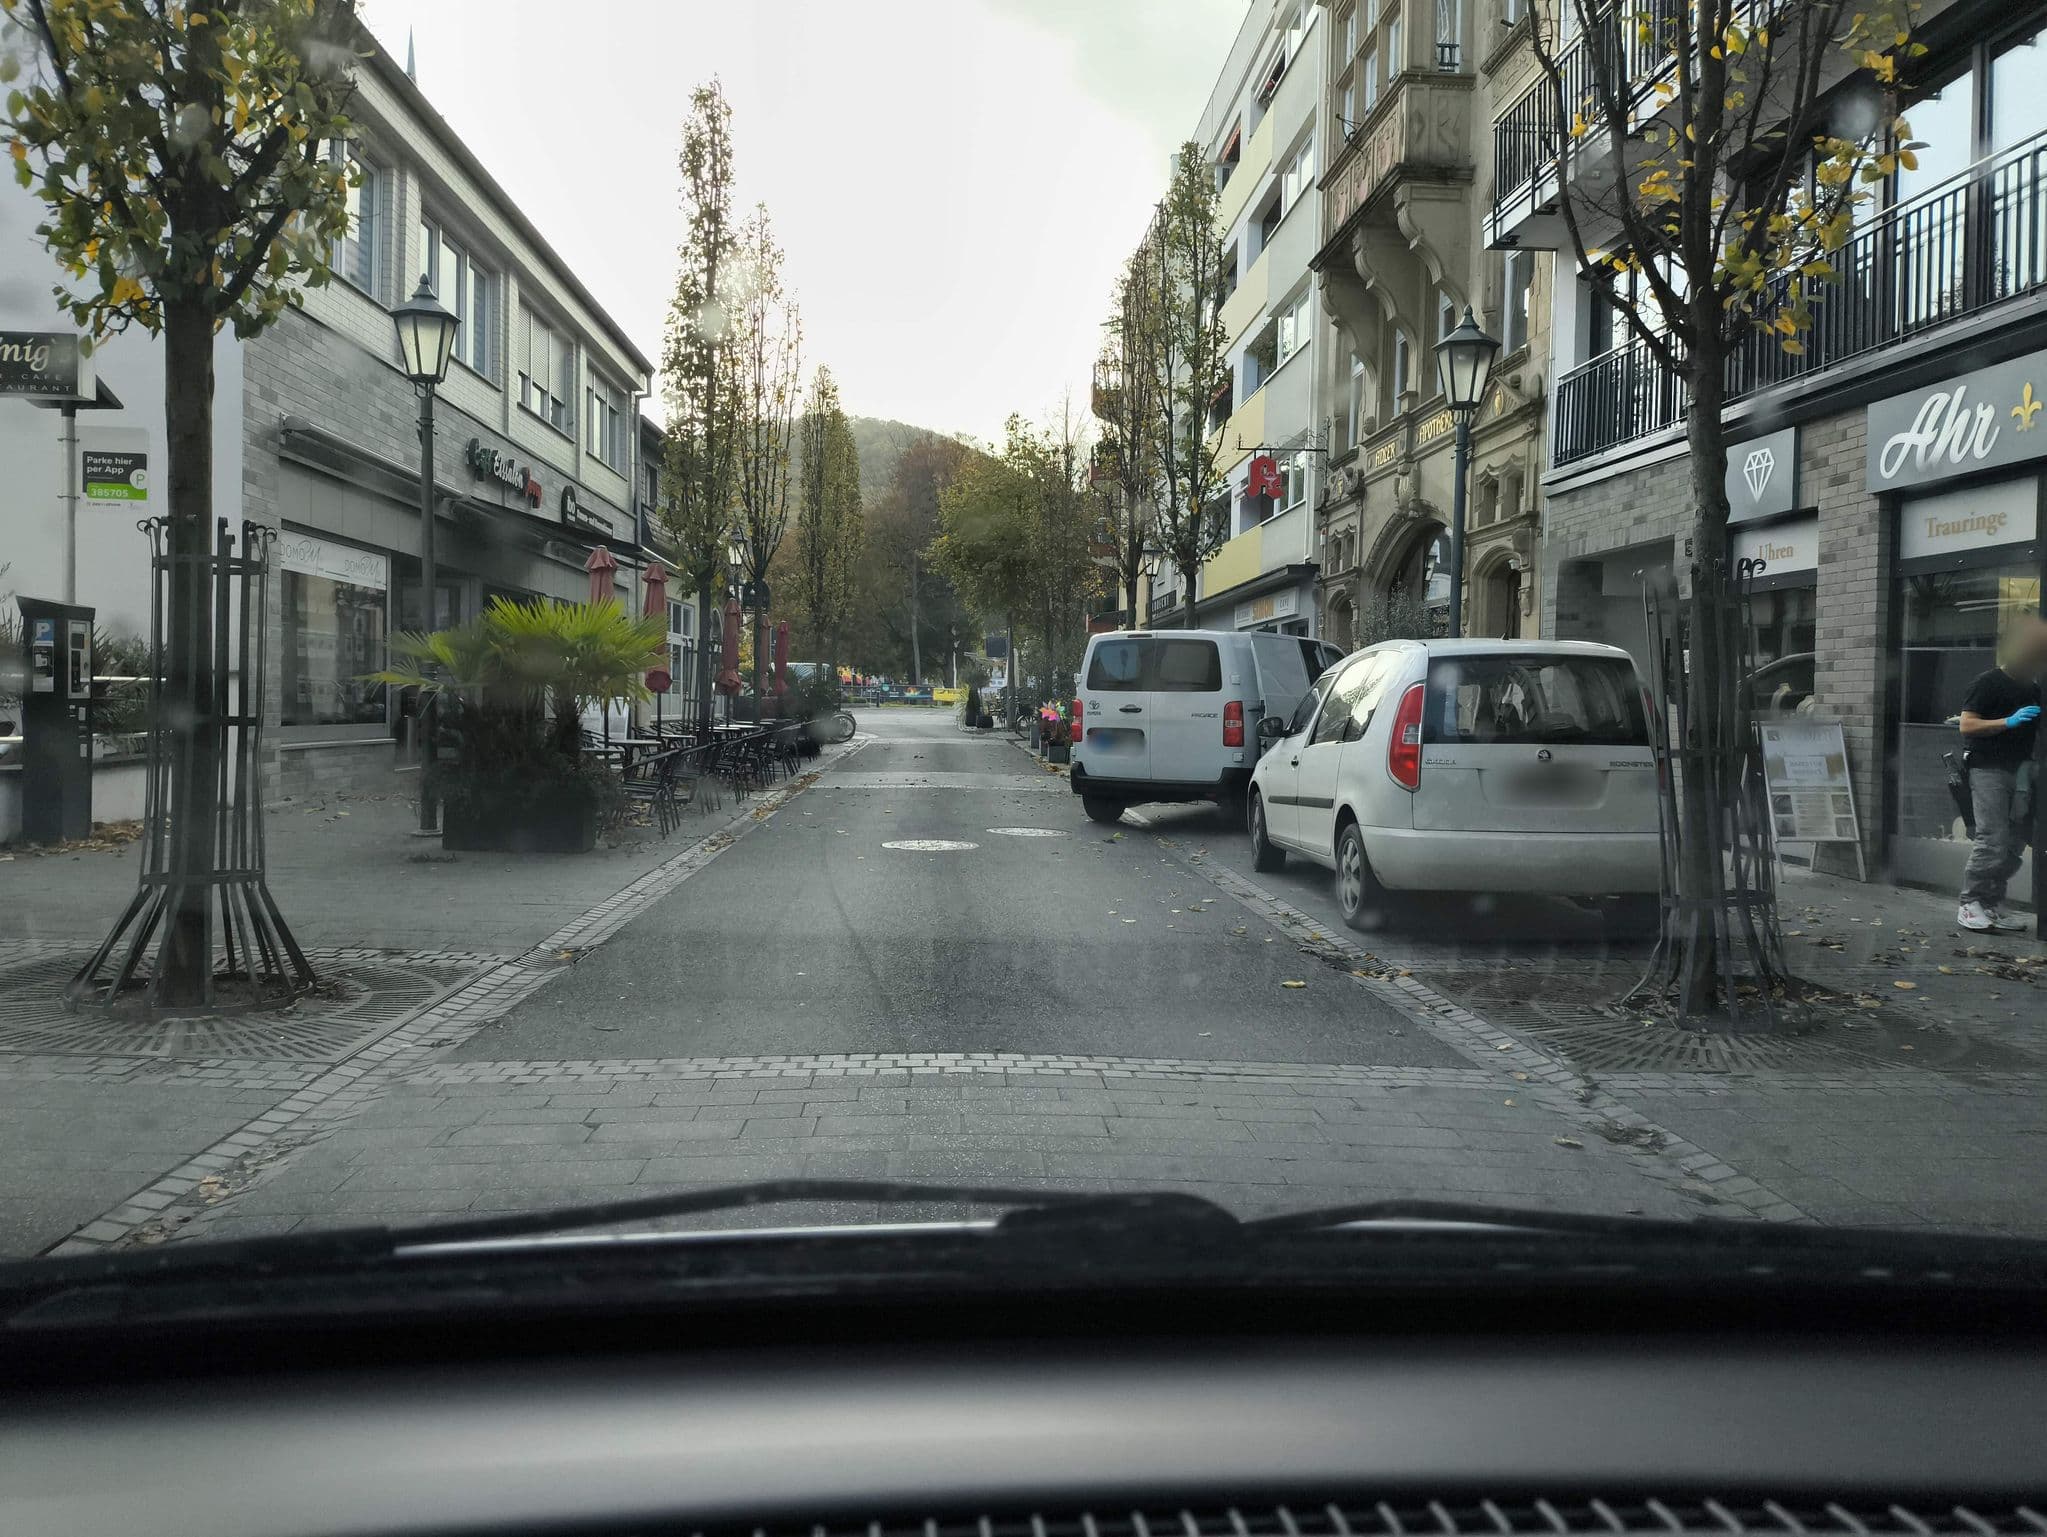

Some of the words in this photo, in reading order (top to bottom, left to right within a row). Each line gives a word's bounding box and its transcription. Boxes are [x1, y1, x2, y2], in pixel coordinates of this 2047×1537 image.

[0, 384, 72, 392] AURANT
[1880, 385, 2000, 480] Ahr
[87, 456, 113, 464] Parke
[115, 457, 134, 465] hier
[104, 466, 124, 475] App
[91, 488, 129, 498] 385705
[1926, 511, 2007, 537] Trauringe
[1759, 542, 1794, 560] Uhren
[36, 622, 51, 639] P
